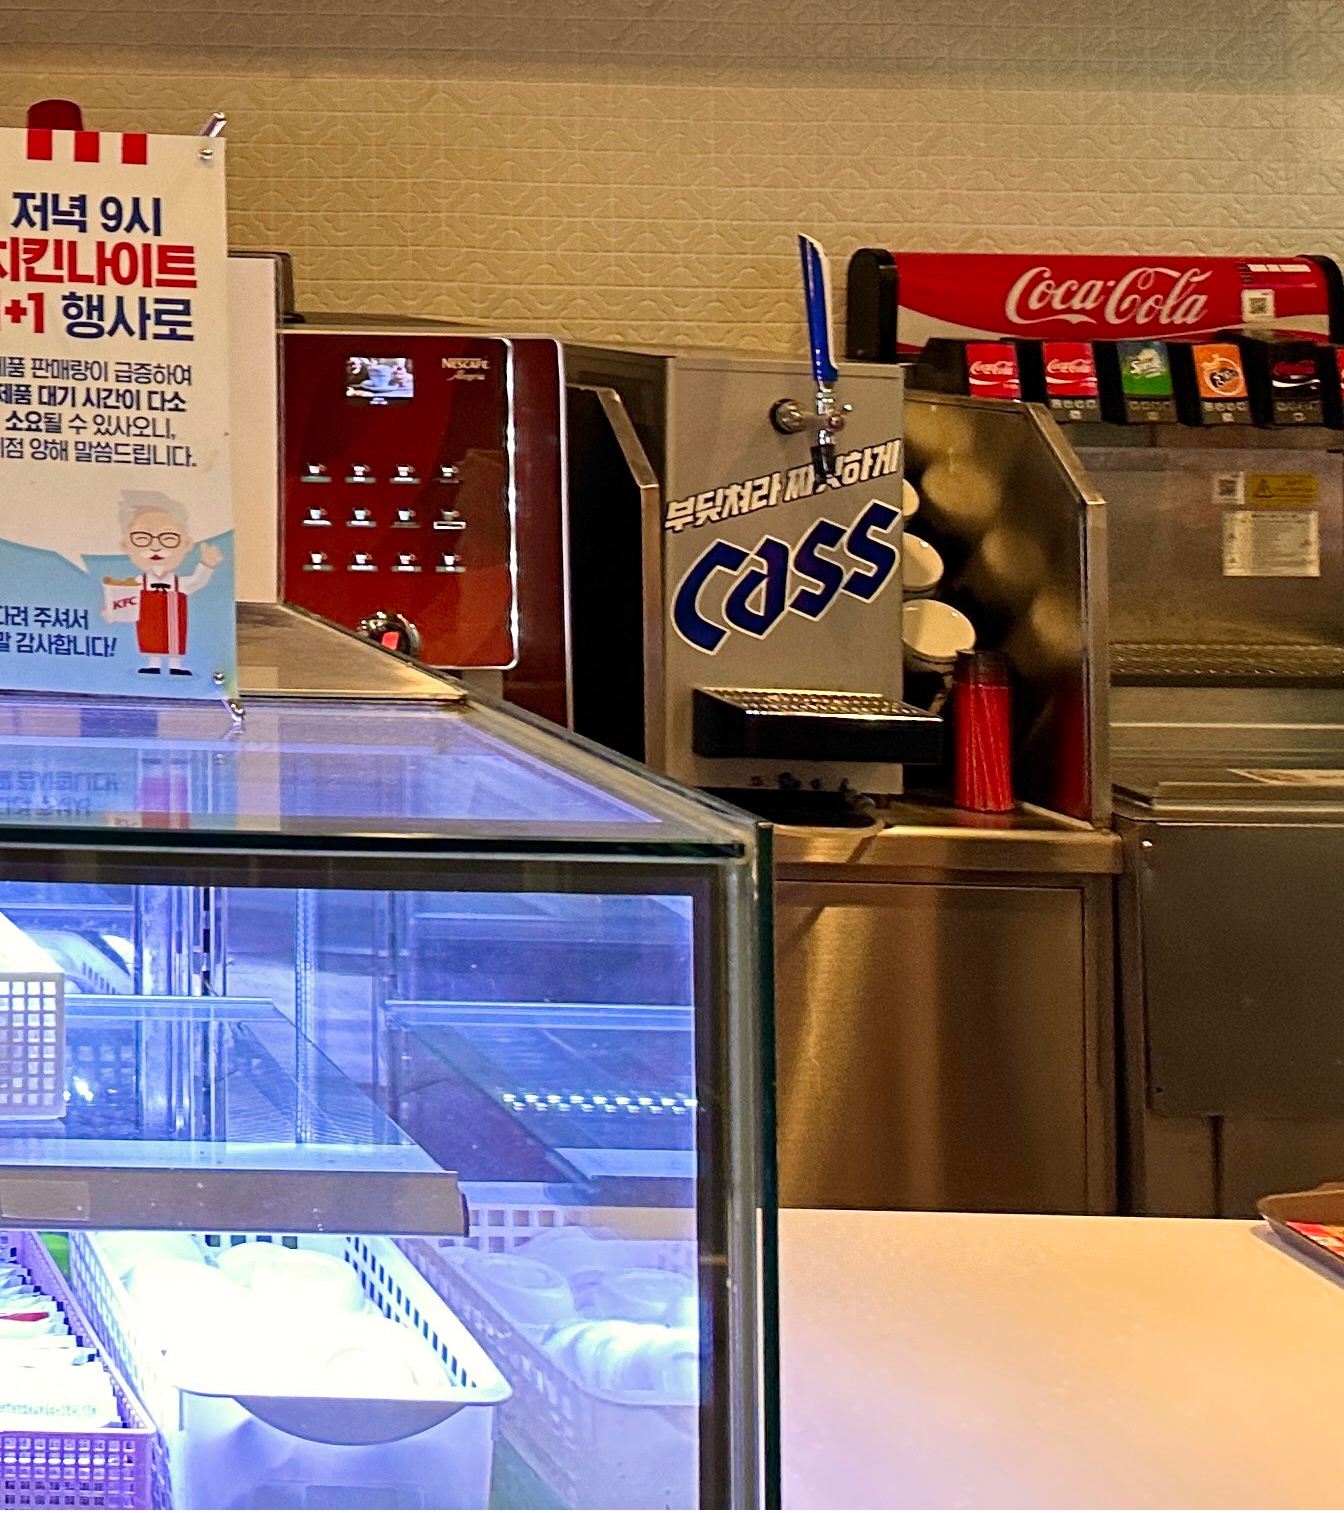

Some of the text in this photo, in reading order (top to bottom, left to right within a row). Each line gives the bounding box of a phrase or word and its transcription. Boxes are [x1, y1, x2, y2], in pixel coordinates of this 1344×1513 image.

[11, 191, 162, 237] 저녁 9시
[1005, 266, 1213, 326] Coca-Cola
[61, 292, 195, 342] 행사로
[30, 358, 109, 383] 판매량이
[113, 361, 192, 386] 급증하여
[38, 384, 76, 408] 대기
[84, 387, 141, 411] 시간이
[147, 390, 188, 413] 다소
[5, 410, 177, 440] 소요될 수 있사오니,
[30, 437, 69, 462] 양해
[74, 440, 198, 467] 말씀드립니다.
[113, 596, 138, 610] KFC
[33, 606, 90, 630] 주셔서
[15, 632, 118, 658] 감사합니다!
